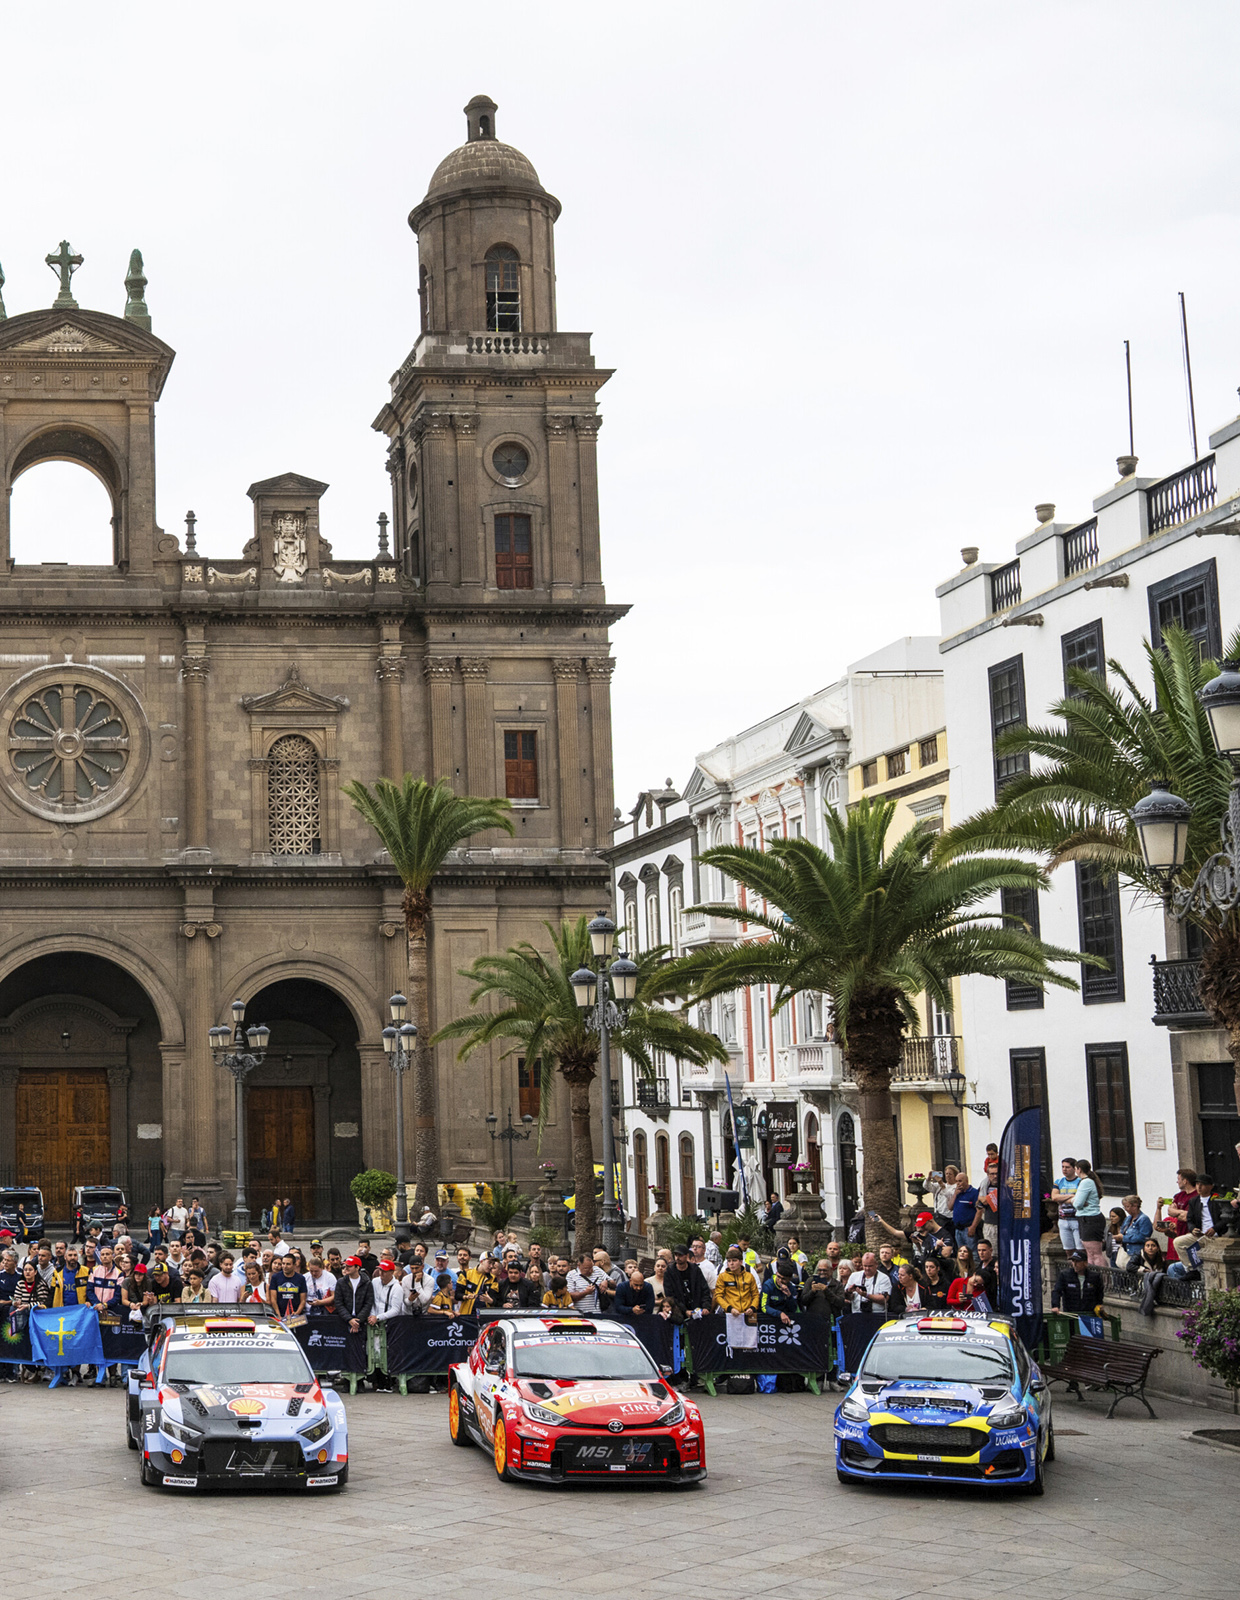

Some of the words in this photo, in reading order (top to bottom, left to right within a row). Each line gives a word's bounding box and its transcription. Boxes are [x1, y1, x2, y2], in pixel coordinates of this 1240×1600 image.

[1010, 1238, 1024, 1317] WRC
[884, 1335, 994, 1345] WRC-FANSHOP.COM
[227, 1388, 286, 1398] MOBIS
[568, 1388, 644, 1407] repsol
